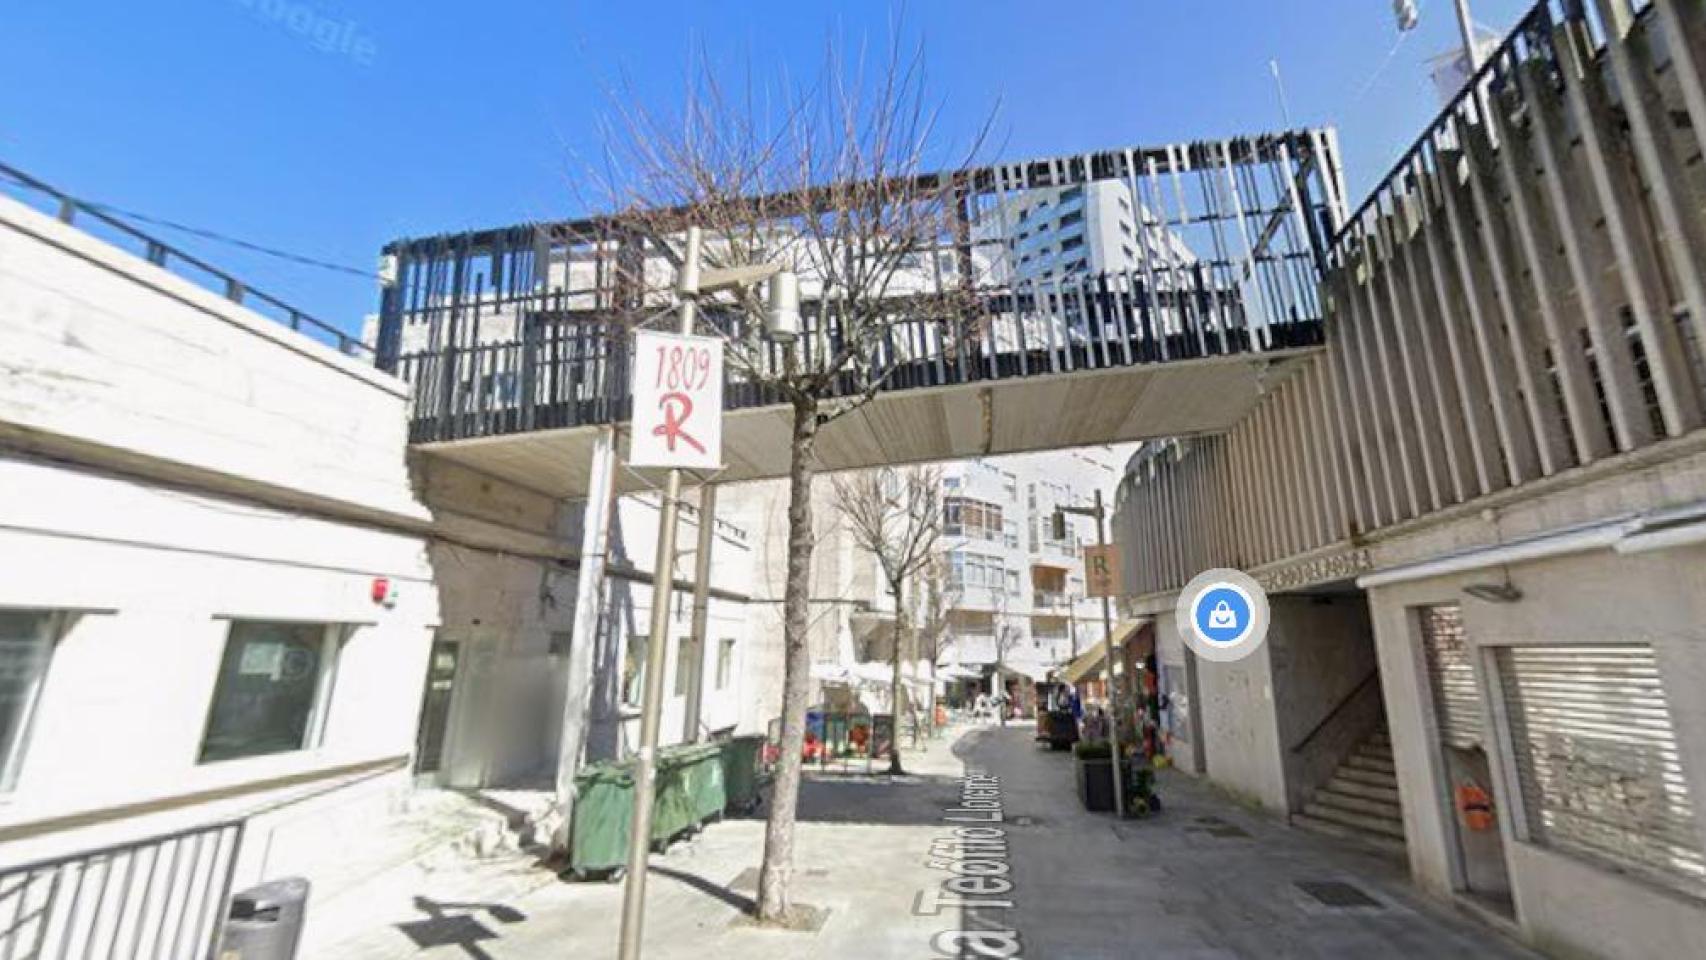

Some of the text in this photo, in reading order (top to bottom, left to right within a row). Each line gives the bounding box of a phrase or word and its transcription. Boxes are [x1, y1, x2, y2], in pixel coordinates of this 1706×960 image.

[655, 346, 710, 391] 1809
[652, 391, 708, 454] R
[1094, 556, 1112, 575] R
